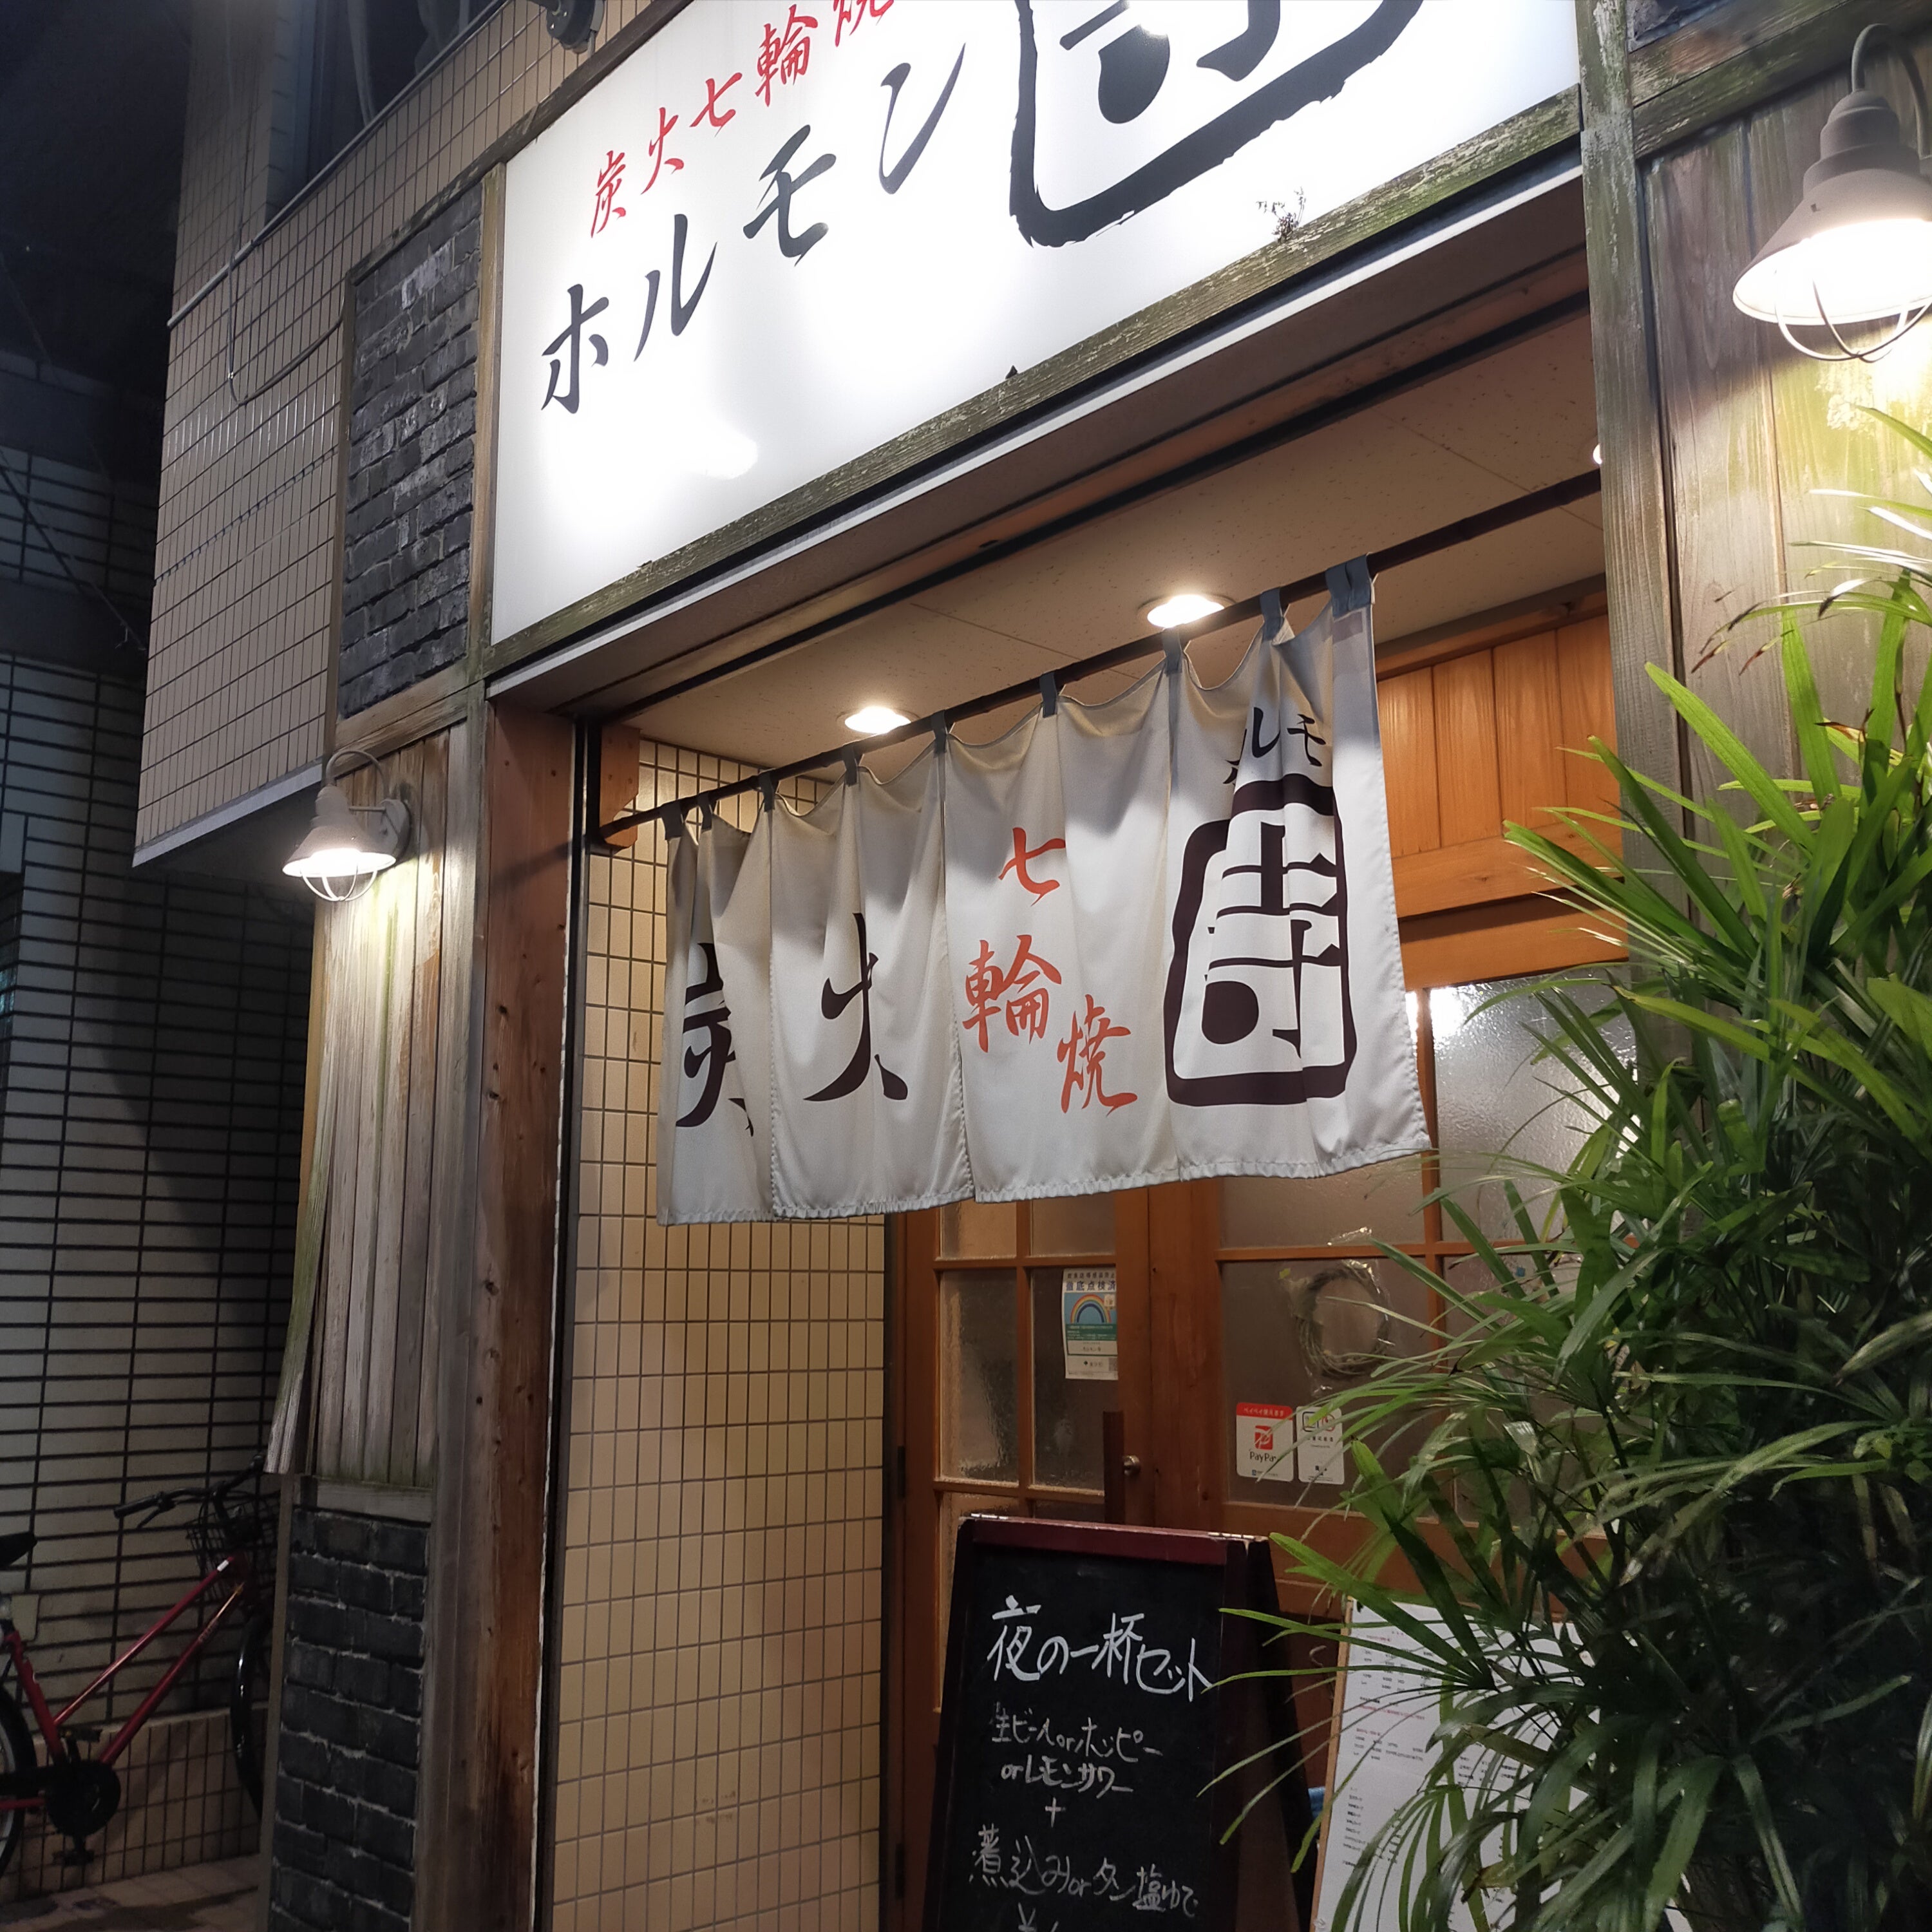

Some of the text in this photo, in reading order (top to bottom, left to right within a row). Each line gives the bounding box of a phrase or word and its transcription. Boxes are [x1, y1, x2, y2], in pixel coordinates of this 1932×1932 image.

[541, 42, 966, 414] ホルモン
[1249, 1451, 1277, 1463] PayPa
[987, 1595, 1213, 1702] 夜の一杯セット
